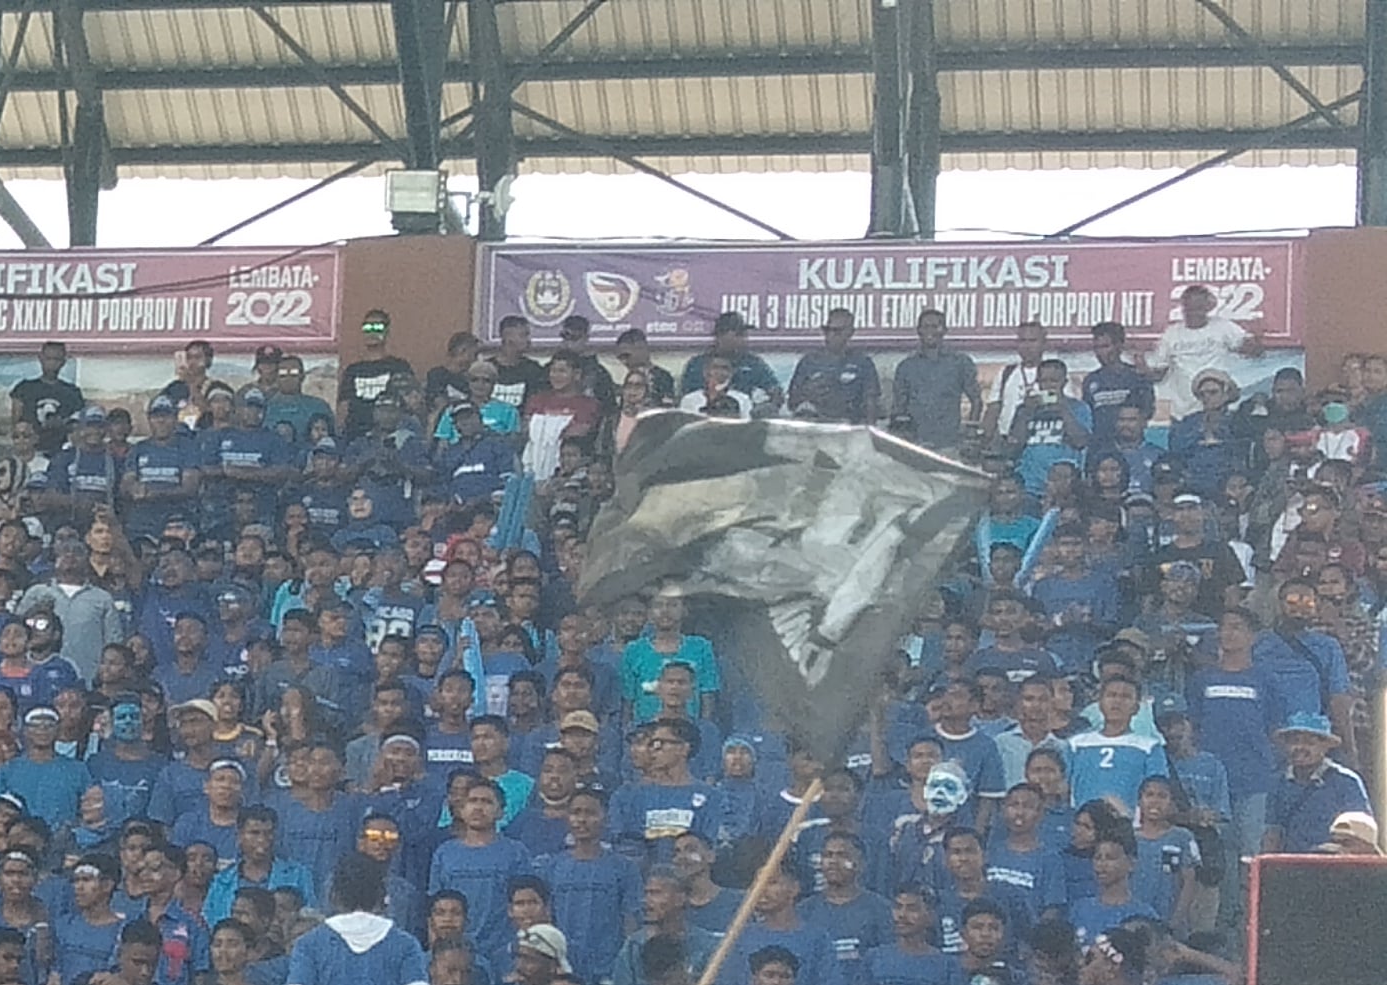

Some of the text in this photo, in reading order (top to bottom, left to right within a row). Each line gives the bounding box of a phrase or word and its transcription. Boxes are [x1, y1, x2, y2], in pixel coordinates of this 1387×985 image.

[798, 255, 1069, 290] KUALIFIKASI
[12, 298, 53, 332] XXXI
[57, 298, 93, 332] DAN
[97, 298, 176, 332] PORPROV
[181, 298, 214, 332] NTT
[226, 291, 313, 325] 2022
[766, 293, 778, 328] 3
[983, 293, 1021, 328] DAN
[1026, 293, 1115, 328] PORPROV
[1120, 293, 1154, 328] NTT
[1099, 747, 1115, 768] 2
